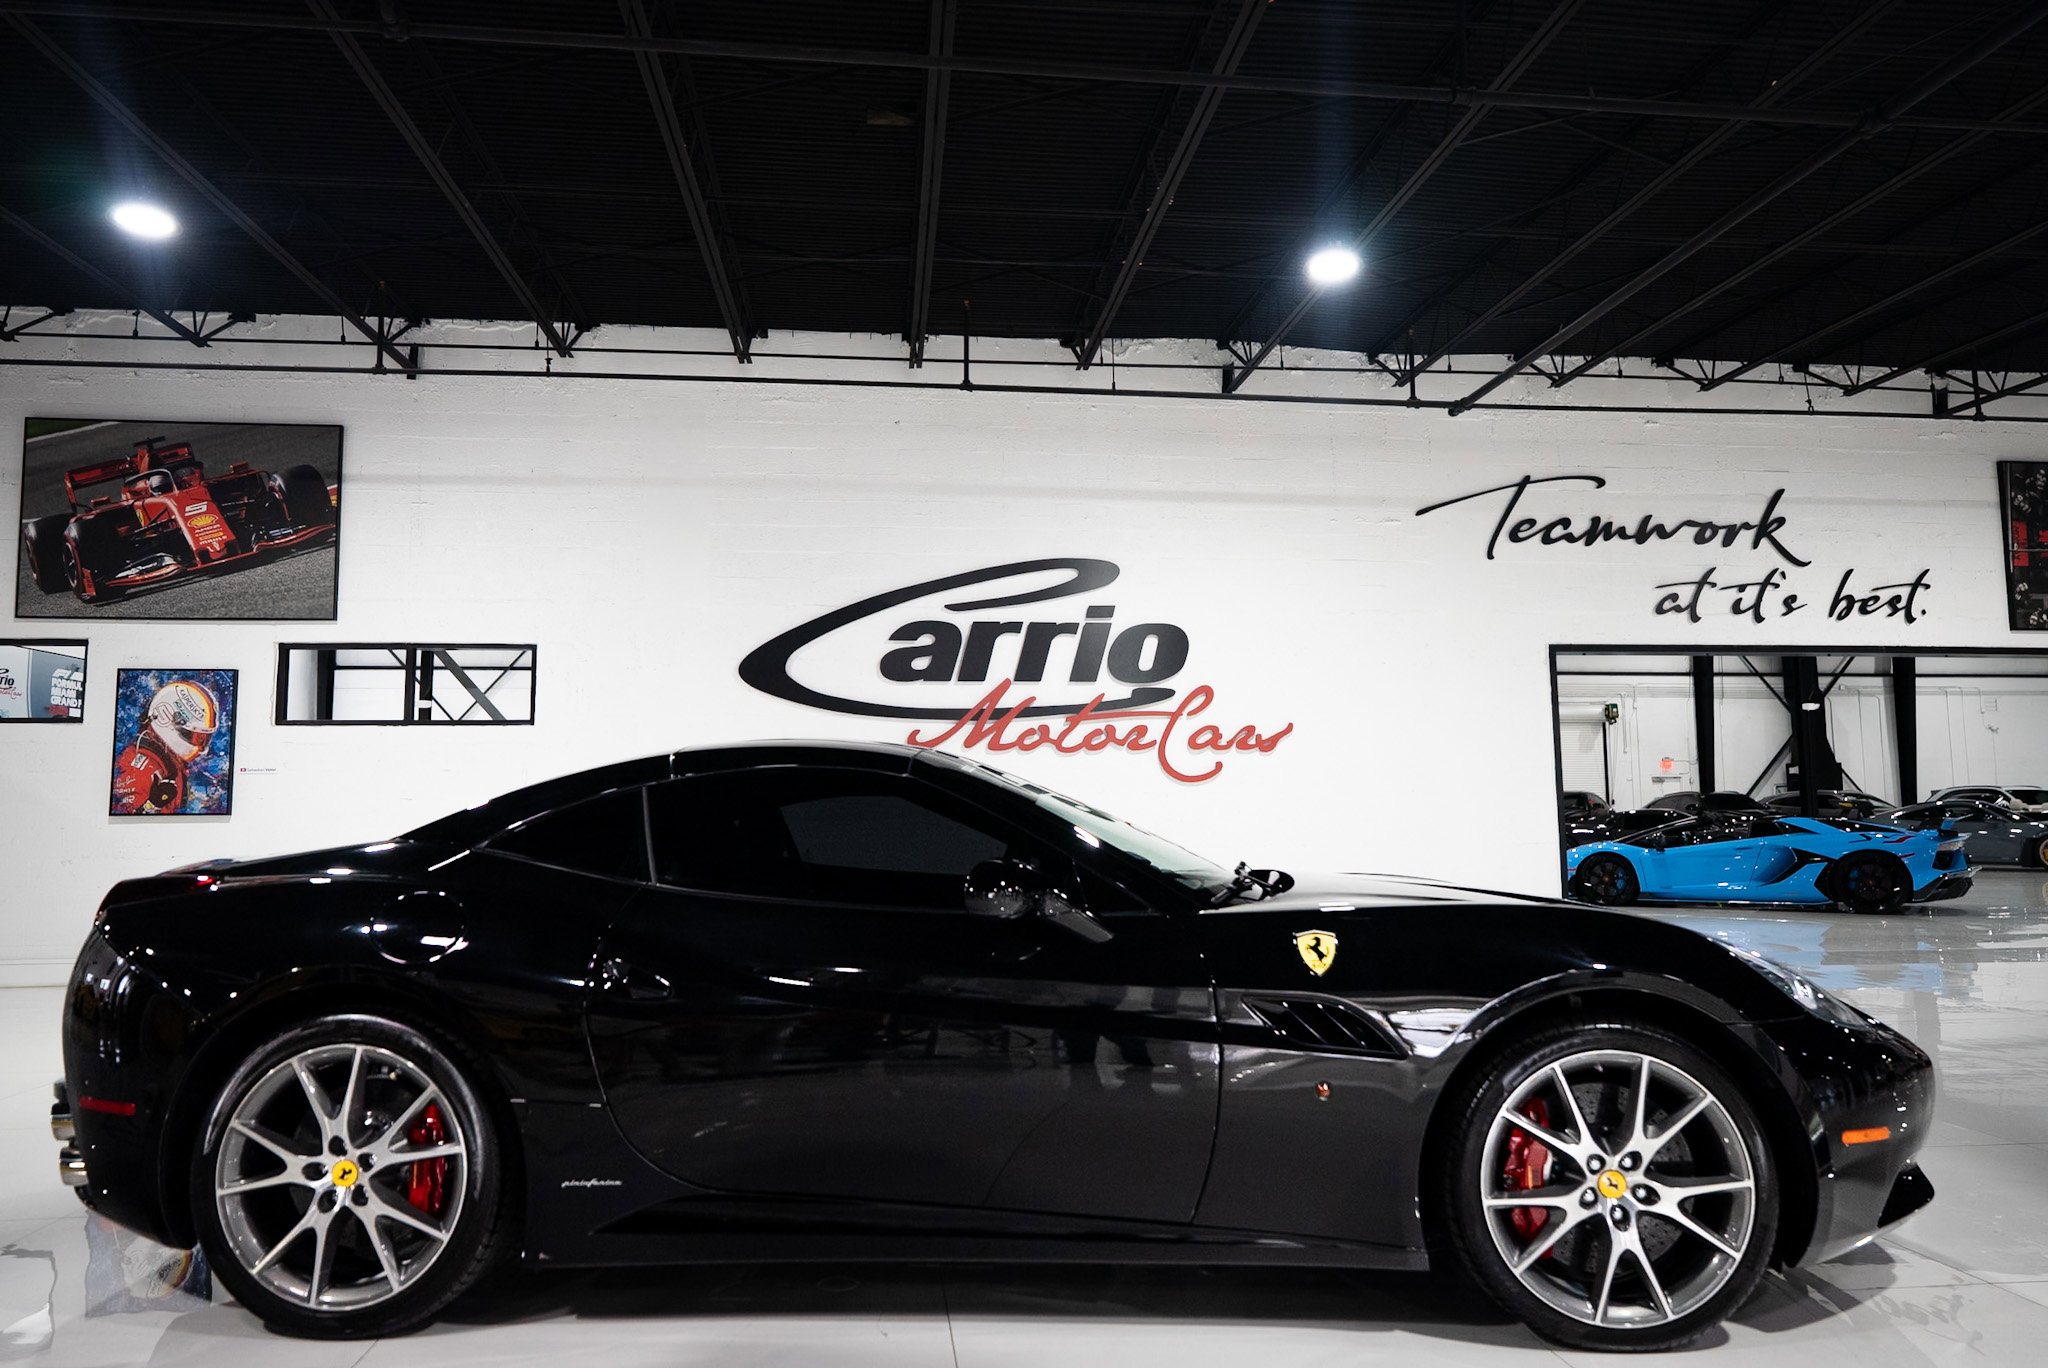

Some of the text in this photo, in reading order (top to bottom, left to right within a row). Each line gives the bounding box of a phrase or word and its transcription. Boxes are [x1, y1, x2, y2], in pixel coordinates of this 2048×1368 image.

[1416, 474, 1812, 567] Teamwork
[738, 558, 1189, 720] Carrio
[1655, 566, 1716, 625] at
[1829, 567, 1931, 626] best.
